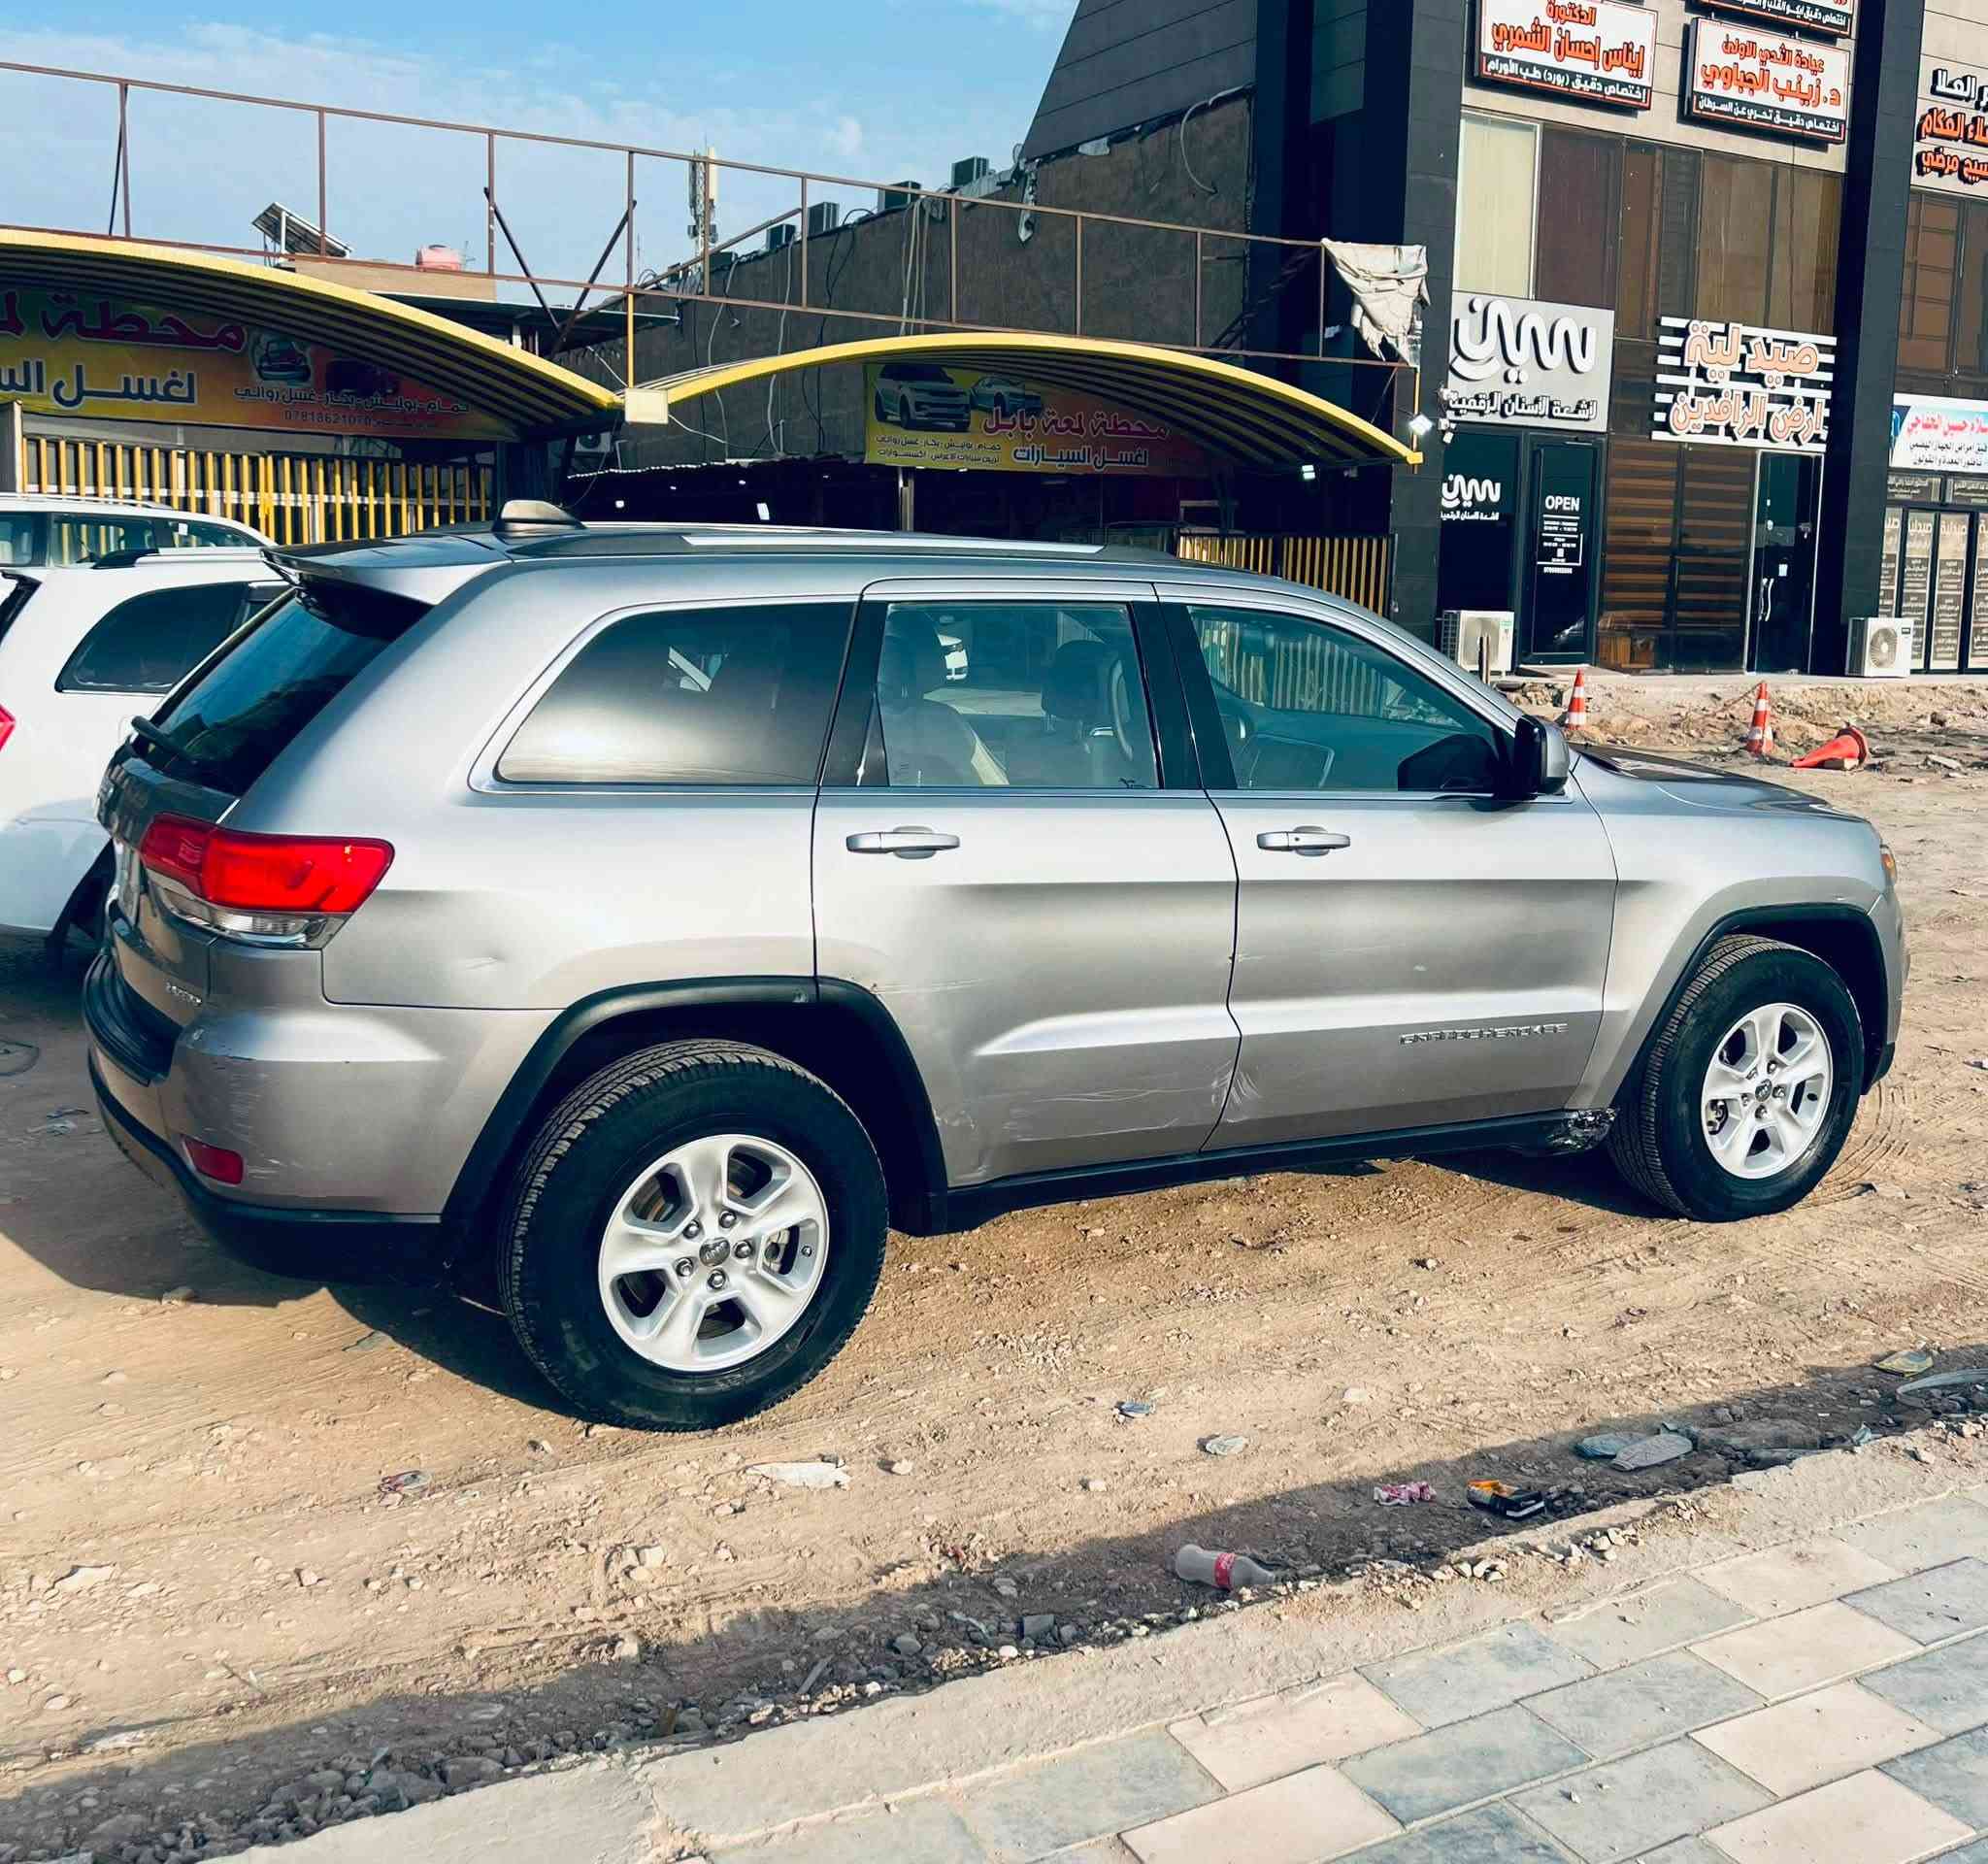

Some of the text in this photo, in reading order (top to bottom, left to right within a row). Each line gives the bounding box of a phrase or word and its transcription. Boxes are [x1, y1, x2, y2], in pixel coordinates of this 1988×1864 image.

[1492, 17, 1552, 52] الشمري
[1758, 43, 1793, 67] الثدي
[1794, 50, 1825, 76] عيادة
[1519, 64, 1542, 81] طب
[1572, 75, 1603, 92] دقيق
[1701, 62, 1771, 96] الجباوي
[1699, 95, 1733, 113] السرطان
[1773, 74, 1821, 108] زينب
[1733, 103, 1747, 116] عن
[1747, 106, 1773, 121] تحري
[1774, 111, 1805, 127] دقيق
[42, 294, 247, 351] محطة
[53, 363, 198, 409] لغسل
[982, 407, 1171, 440] محطة لمعة بابل
[1671, 389, 1769, 437] الرافدين
[1012, 444, 1149, 472] لغسل السيارات
[1544, 495, 1580, 513] OPEN
